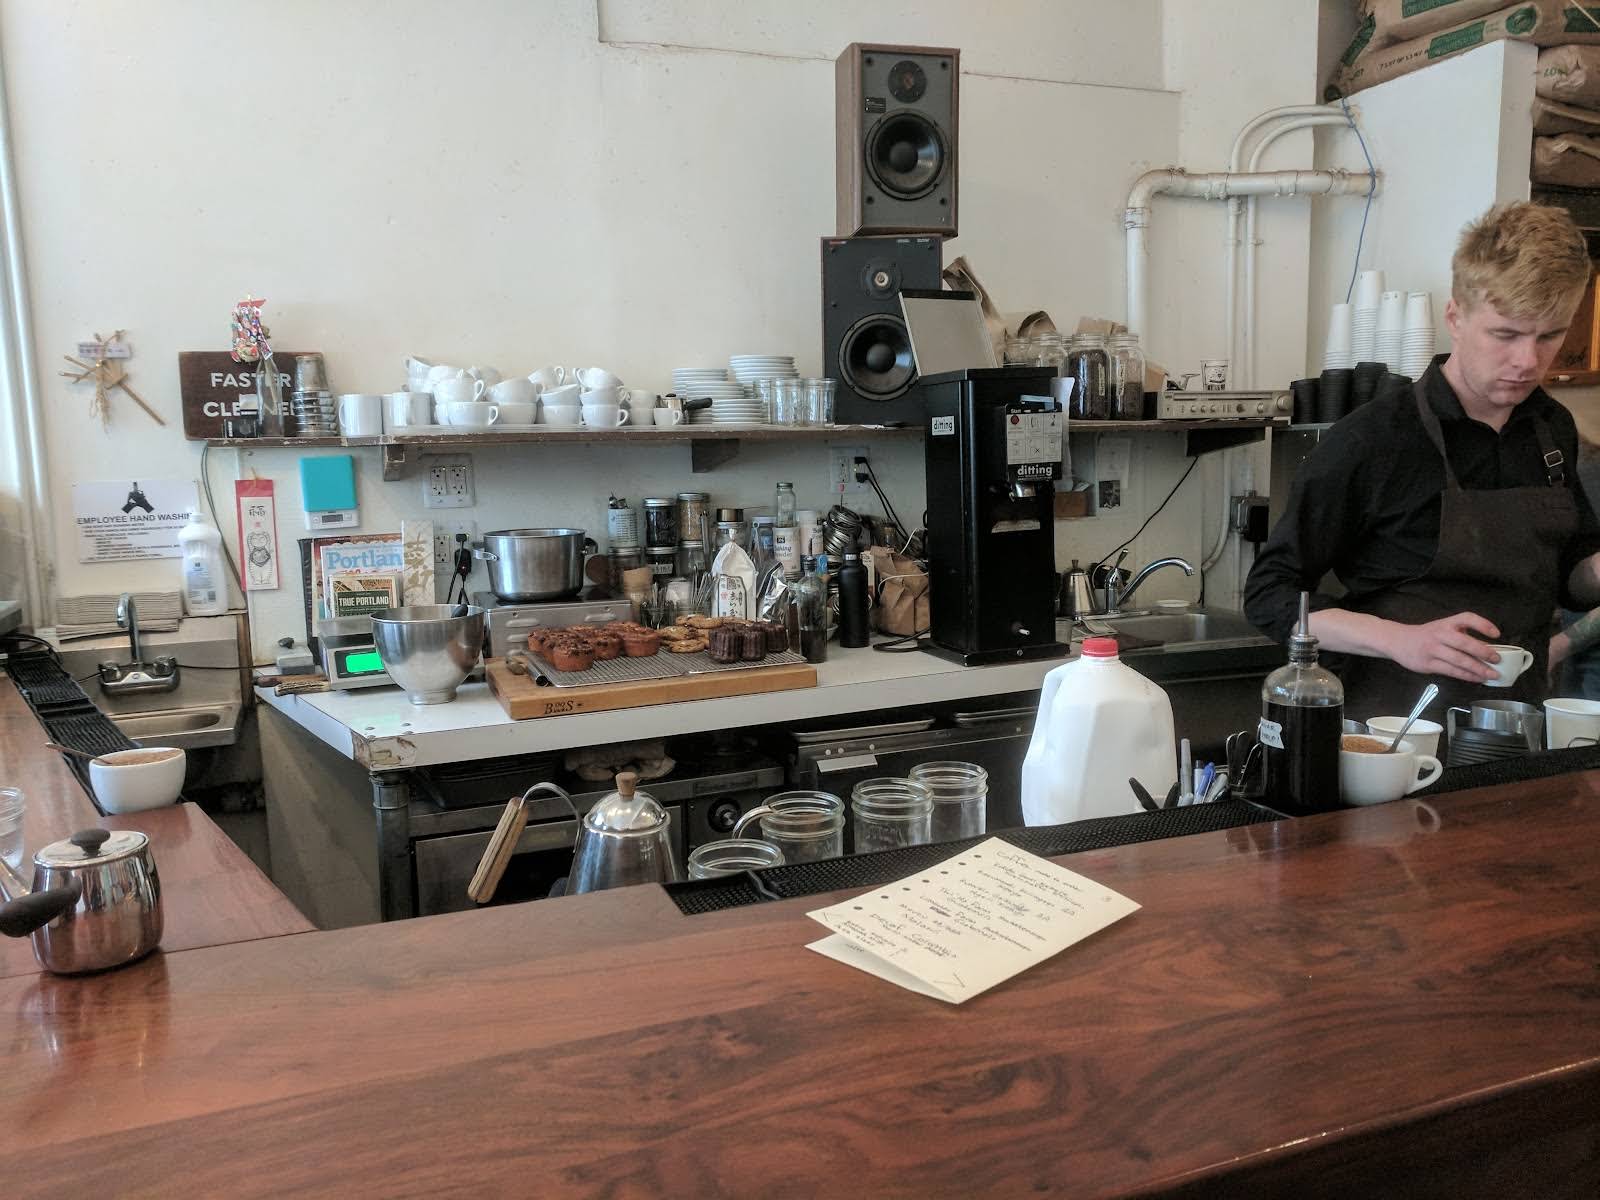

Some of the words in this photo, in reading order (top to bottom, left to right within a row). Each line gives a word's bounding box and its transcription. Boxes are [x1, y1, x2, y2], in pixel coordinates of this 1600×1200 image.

[1017, 464, 1053, 477] ditting
[77, 515, 128, 525] EMPLOYEE
[130, 514, 156, 522] HAND
[156, 512, 193, 521] WASHIN
[325, 549, 404, 570] Portlan
[338, 597, 356, 607] TRUE
[355, 595, 389, 606] PORTLAND
